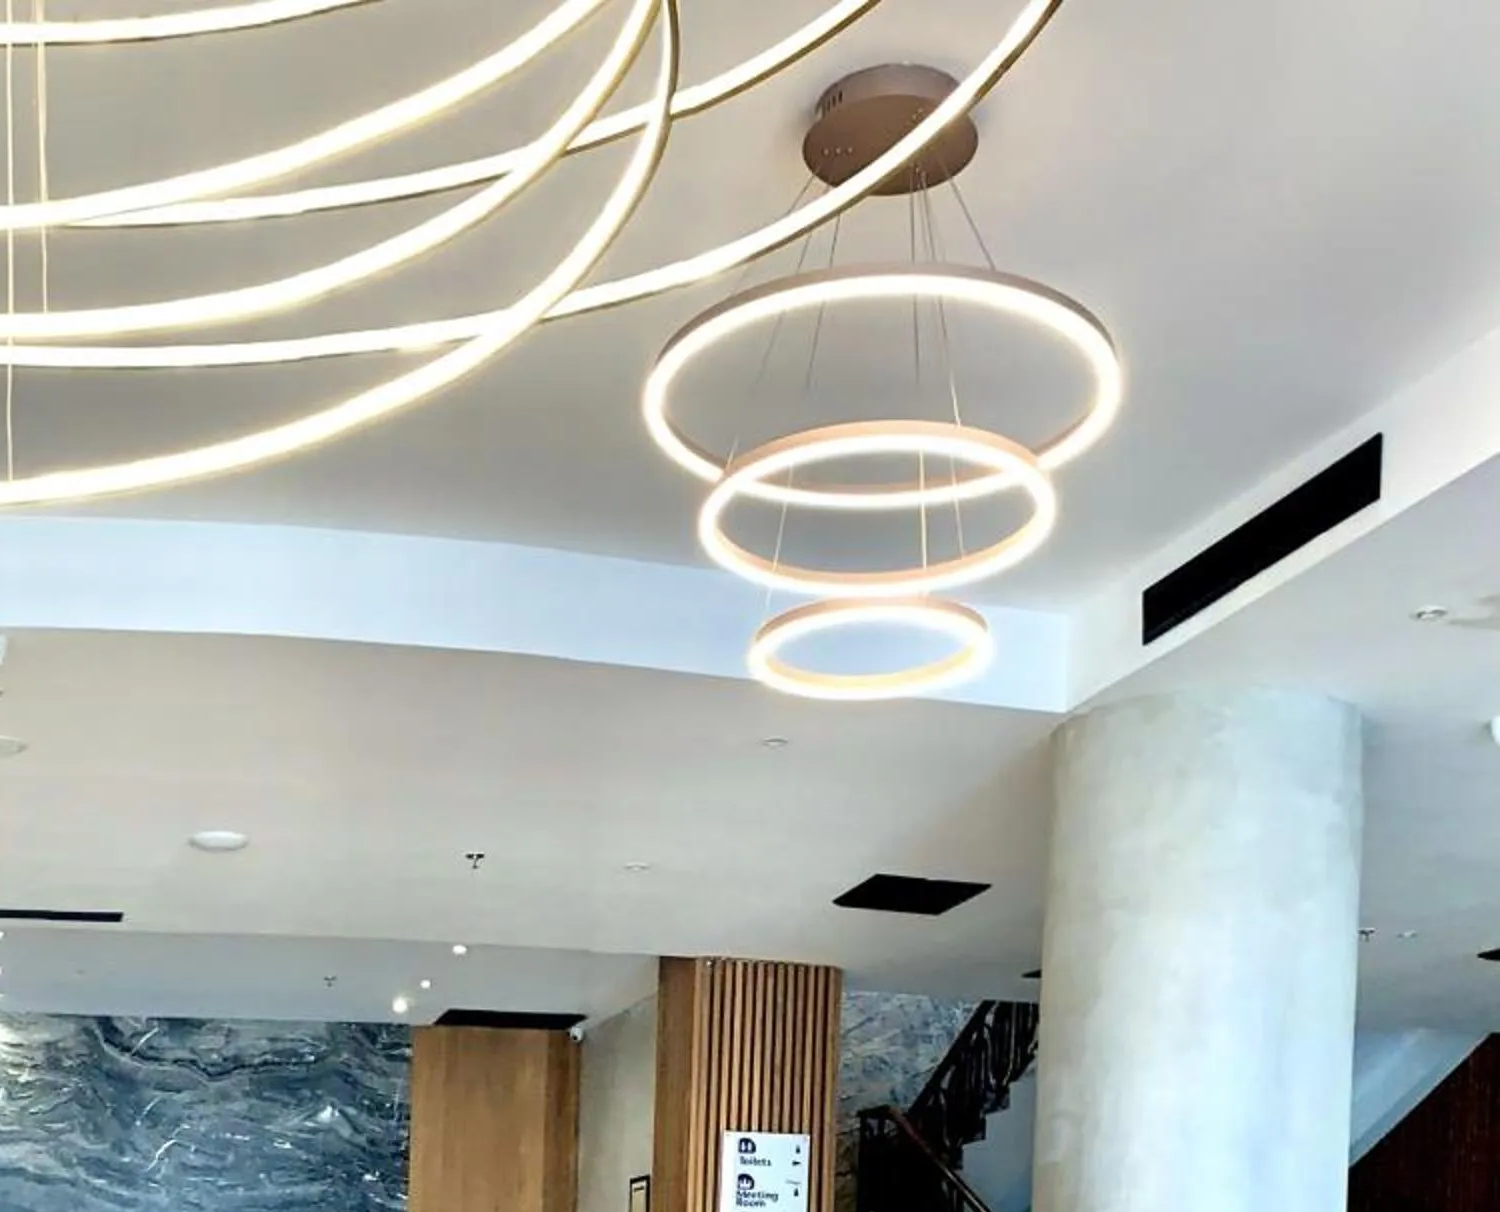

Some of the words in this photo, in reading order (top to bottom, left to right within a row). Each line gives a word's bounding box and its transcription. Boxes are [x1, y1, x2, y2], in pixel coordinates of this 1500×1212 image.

[739, 1156, 771, 1167] Toilets
[736, 1191, 779, 1203] Meeting
[736, 1199, 766, 1207] Room
